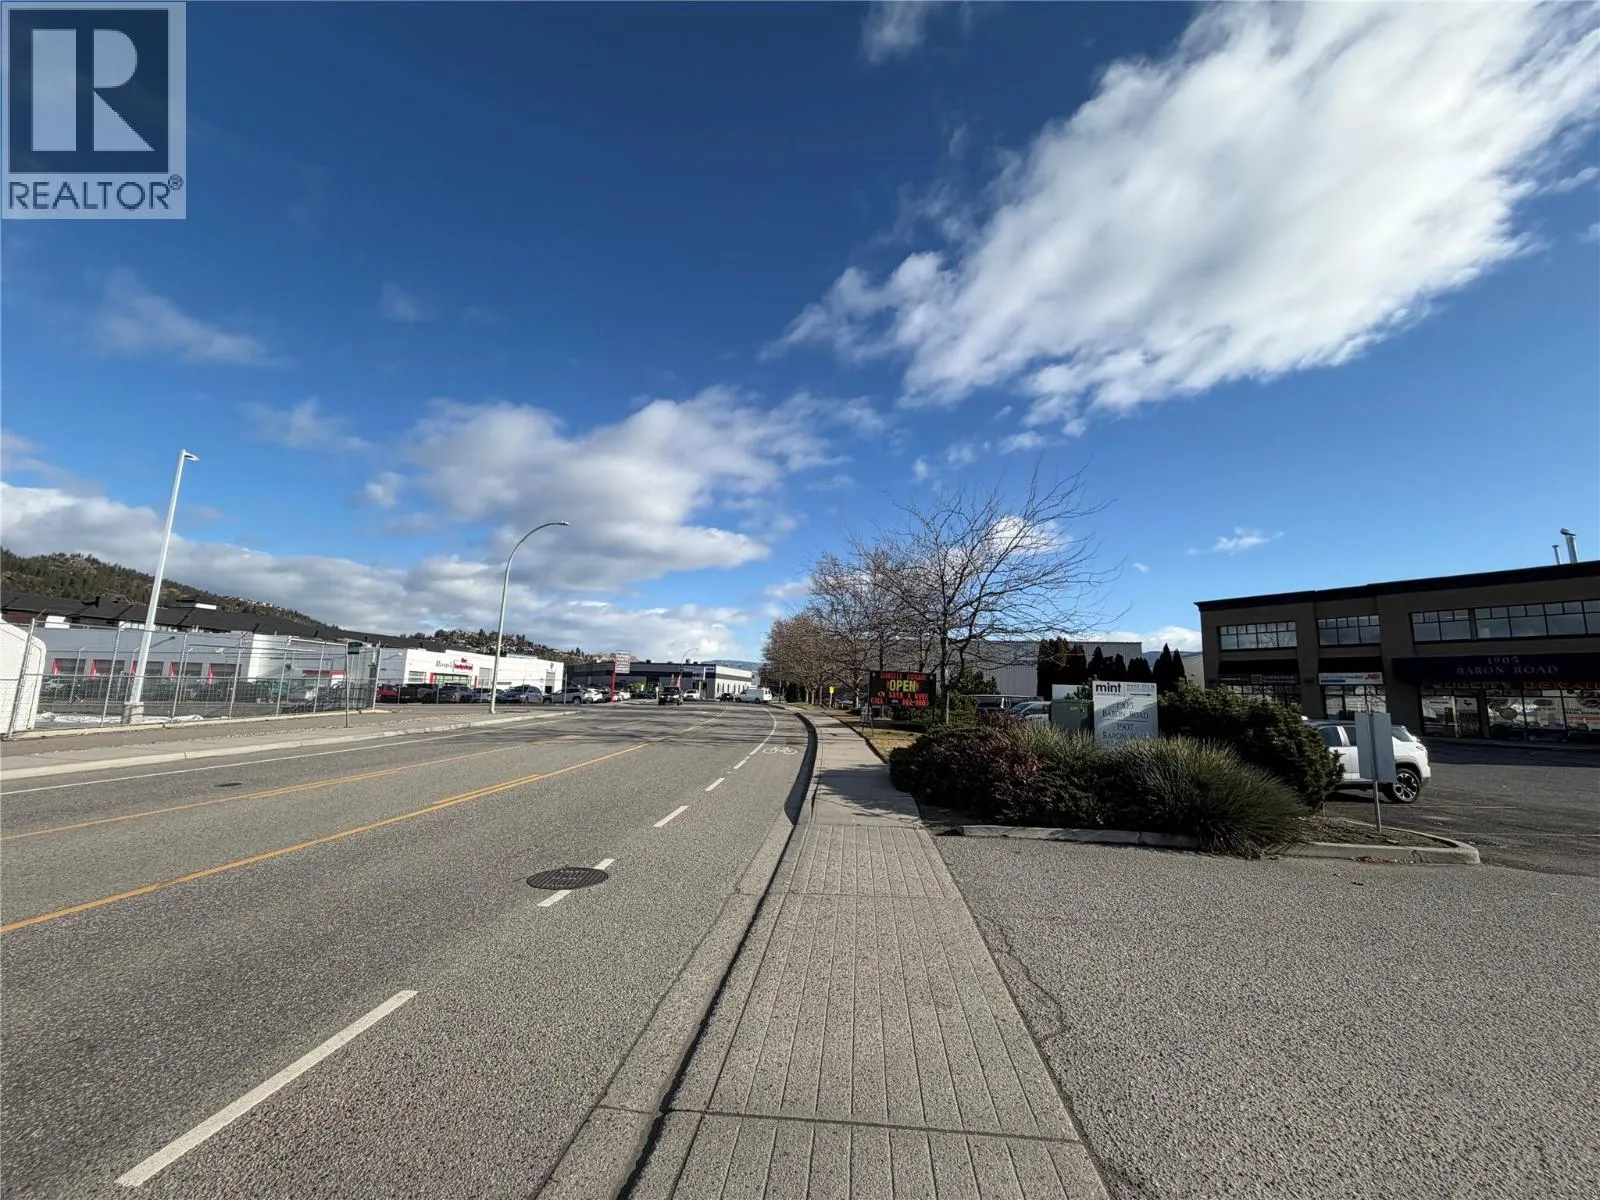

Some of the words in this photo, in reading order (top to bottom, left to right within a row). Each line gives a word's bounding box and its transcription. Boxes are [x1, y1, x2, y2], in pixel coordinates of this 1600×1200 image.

[1487, 656, 1520, 665] 1905
[1455, 666, 1506, 676] BARON
[1513, 665, 1559, 675] ROAD
[889, 679, 916, 692] OPEN
[1096, 682, 1121, 692] mint
[1130, 711, 1148, 719] ROAD
